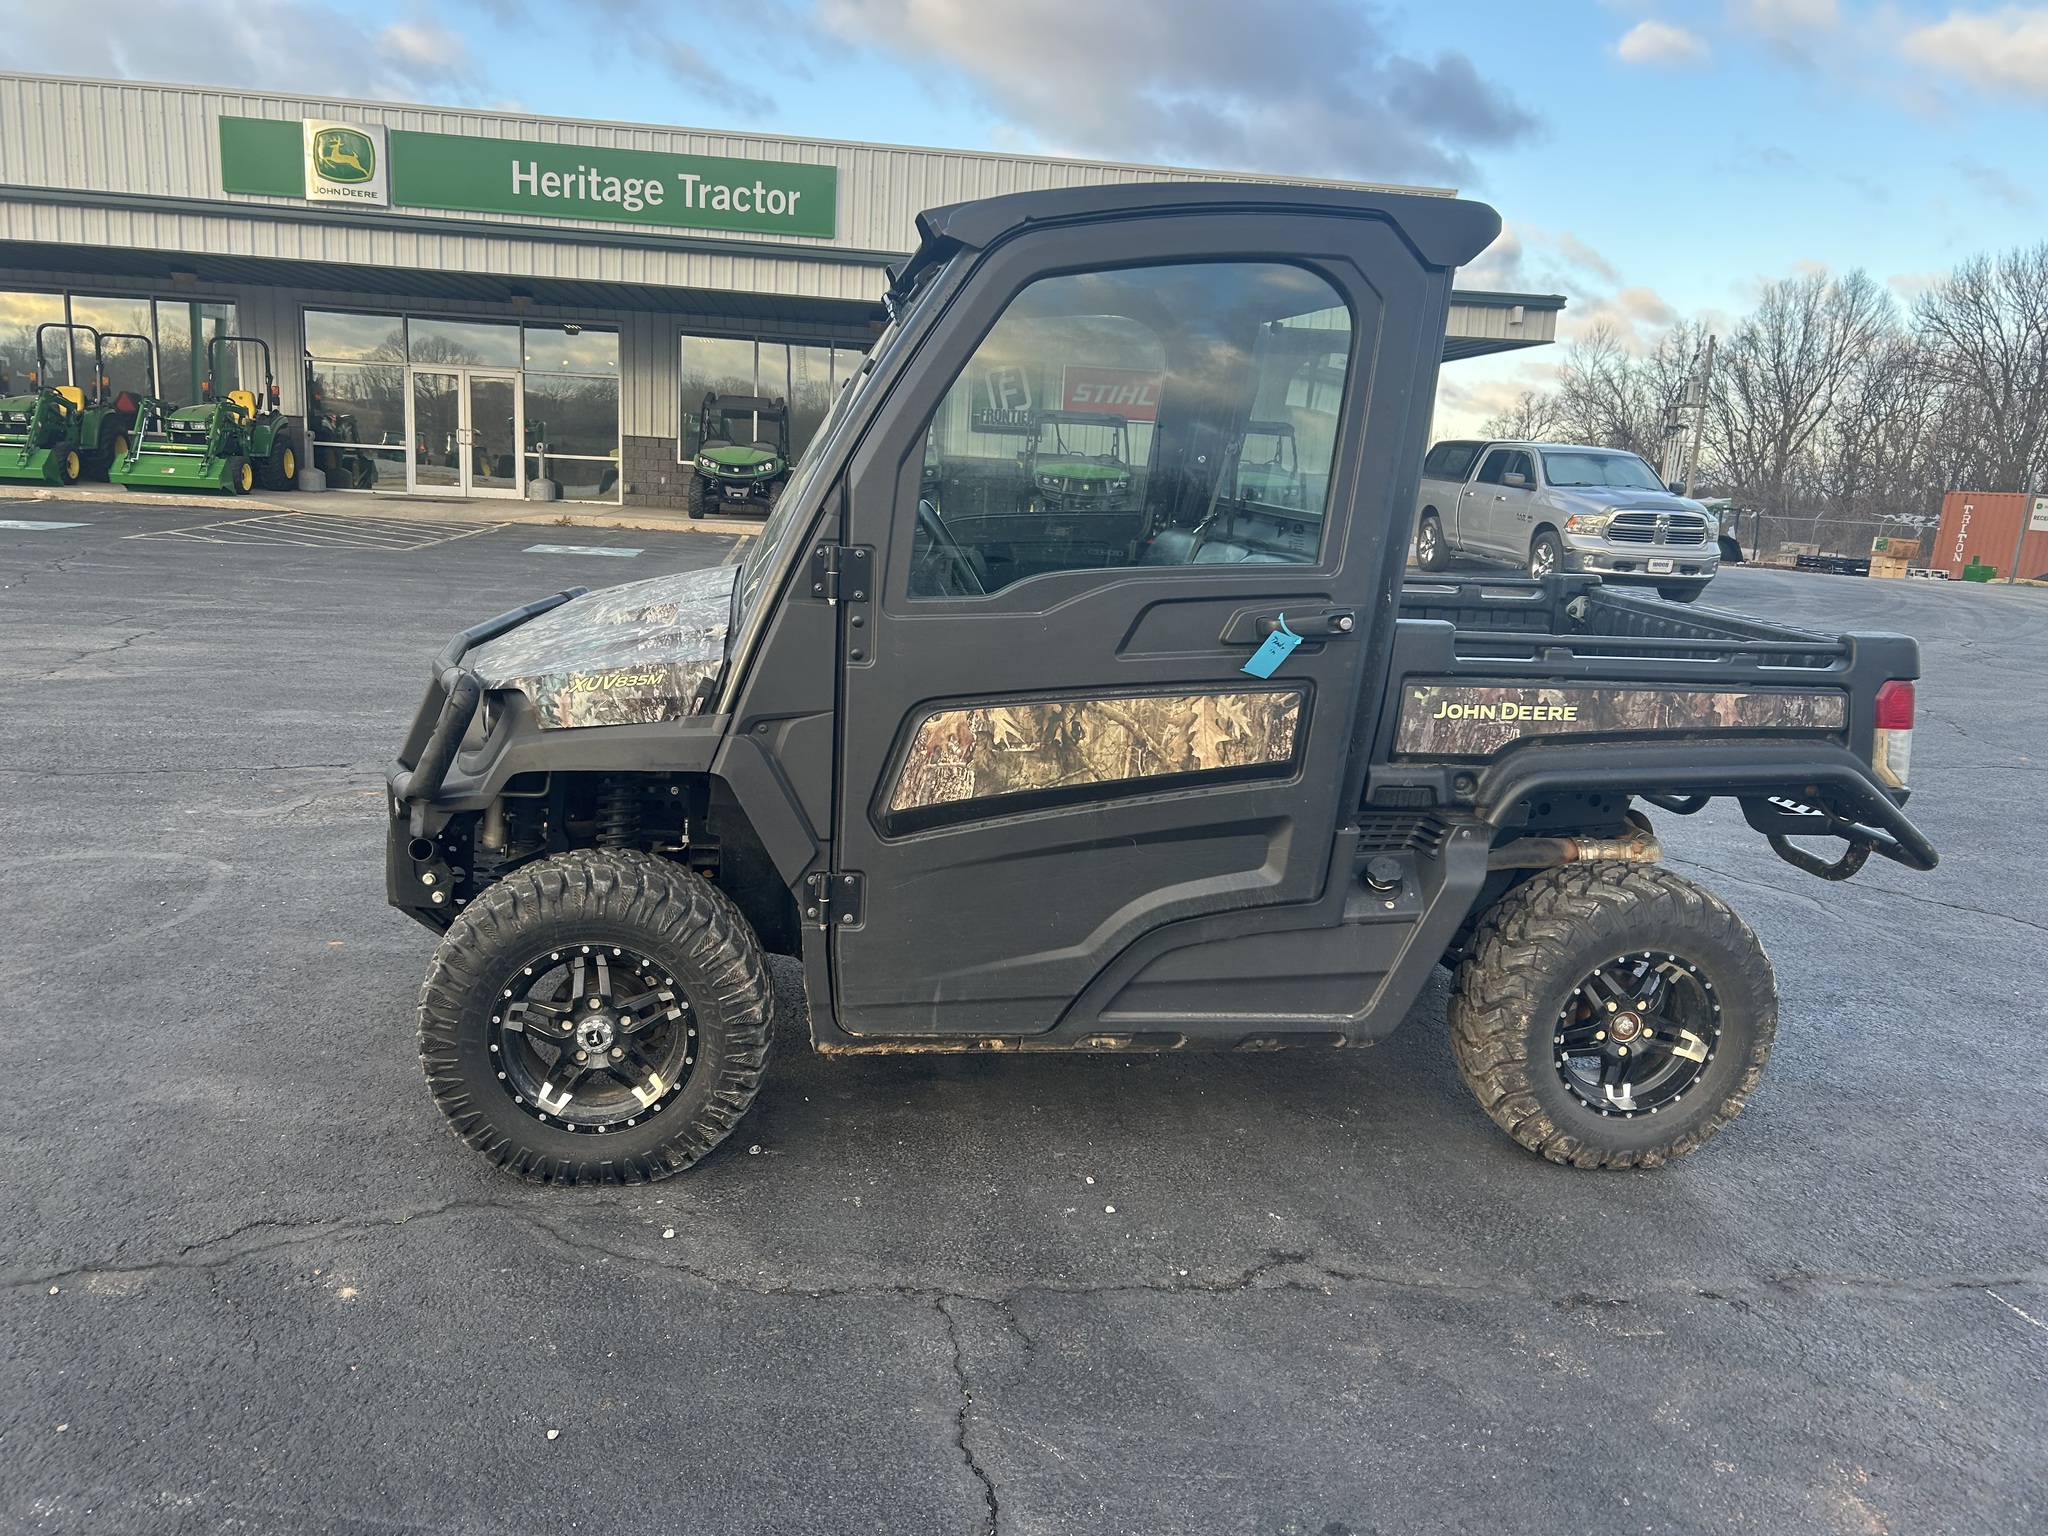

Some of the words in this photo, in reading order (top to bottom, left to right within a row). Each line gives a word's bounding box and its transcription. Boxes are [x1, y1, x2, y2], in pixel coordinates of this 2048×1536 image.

[314, 186, 340, 195] JOHN
[342, 188, 378, 199] DEERE
[512, 160, 664, 212] Heritage
[678, 173, 800, 216] Tractor
[1071, 383, 1155, 406] STIHL
[1952, 504, 1974, 562] TRITON
[568, 673, 664, 693] XUV835M
[1433, 701, 1496, 720] JOHN
[1501, 702, 1578, 721] DEERE
